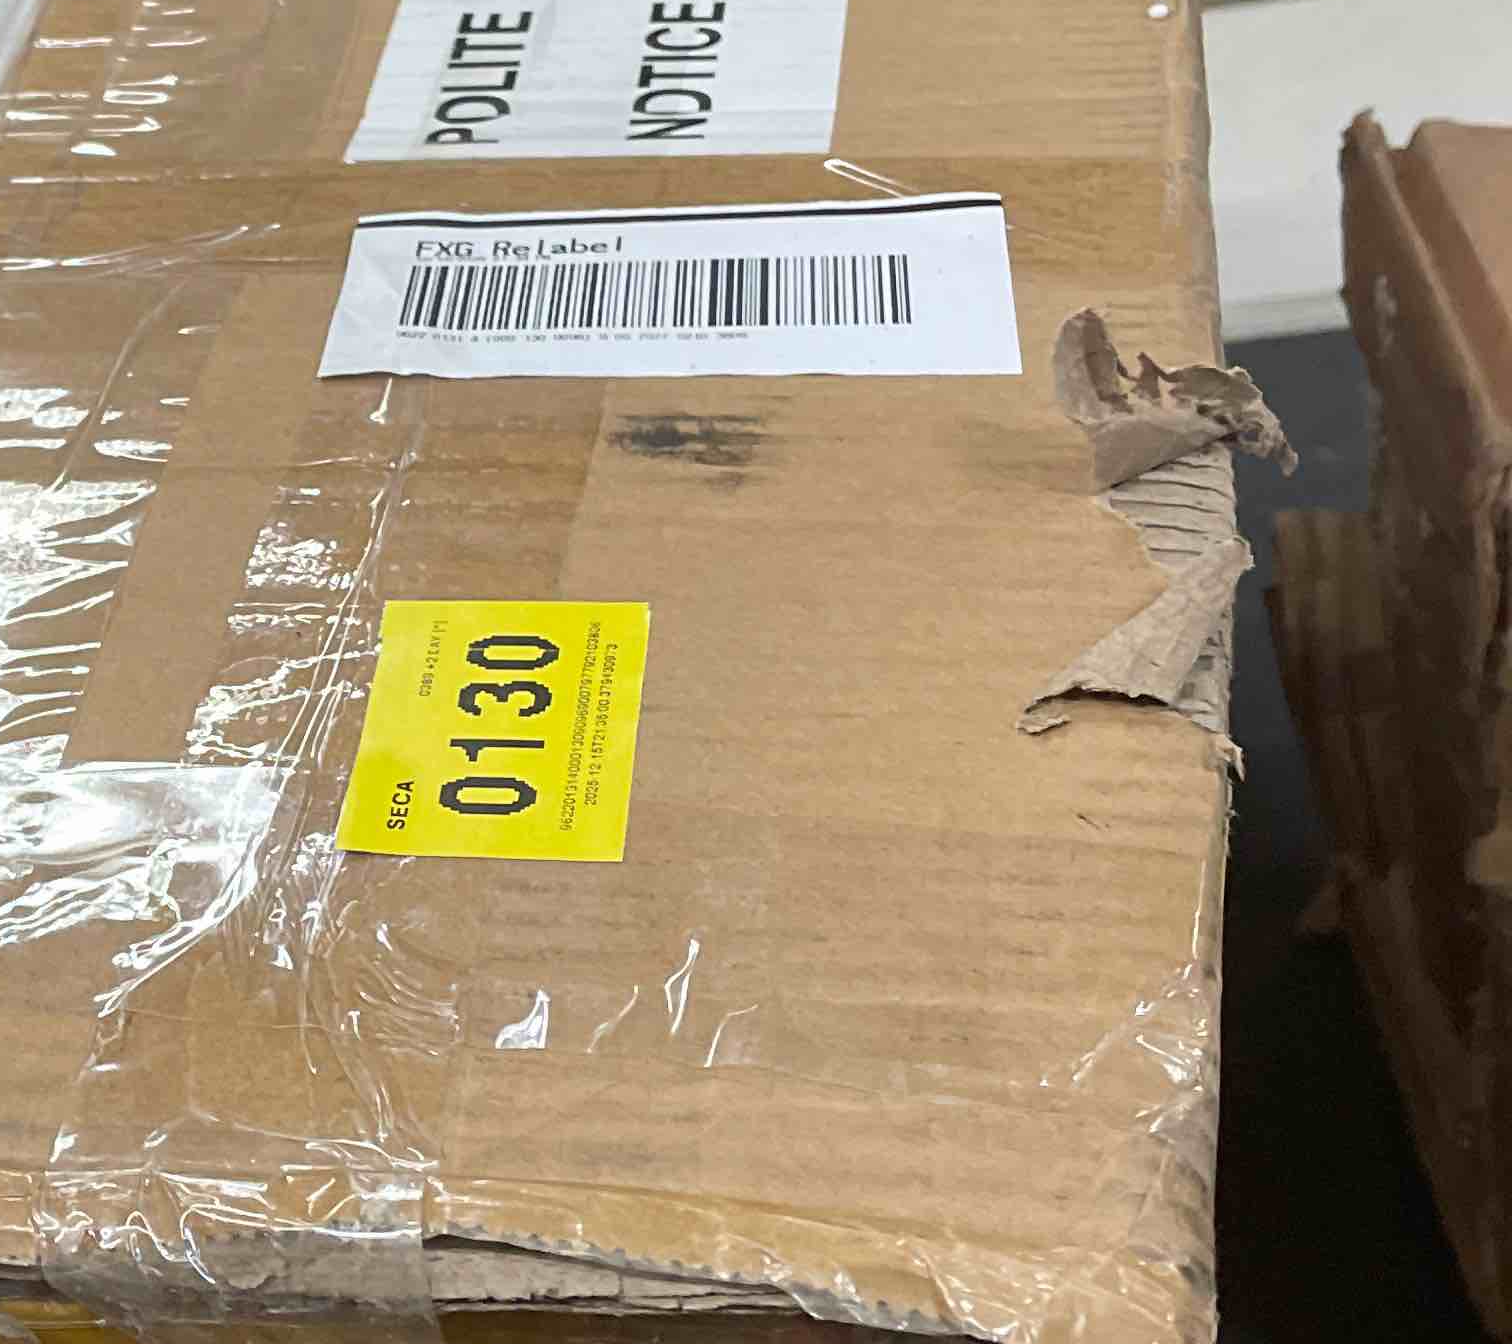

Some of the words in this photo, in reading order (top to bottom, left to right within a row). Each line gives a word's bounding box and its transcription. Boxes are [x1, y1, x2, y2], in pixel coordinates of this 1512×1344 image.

[425, 11, 532, 145] POLITE
[626, 1, 725, 141] NOTICE
[415, 240, 475, 258] FXG
[493, 235, 624, 258] Relabel
[438, 635, 561, 816] 0130
[386, 778, 416, 831] SECA
